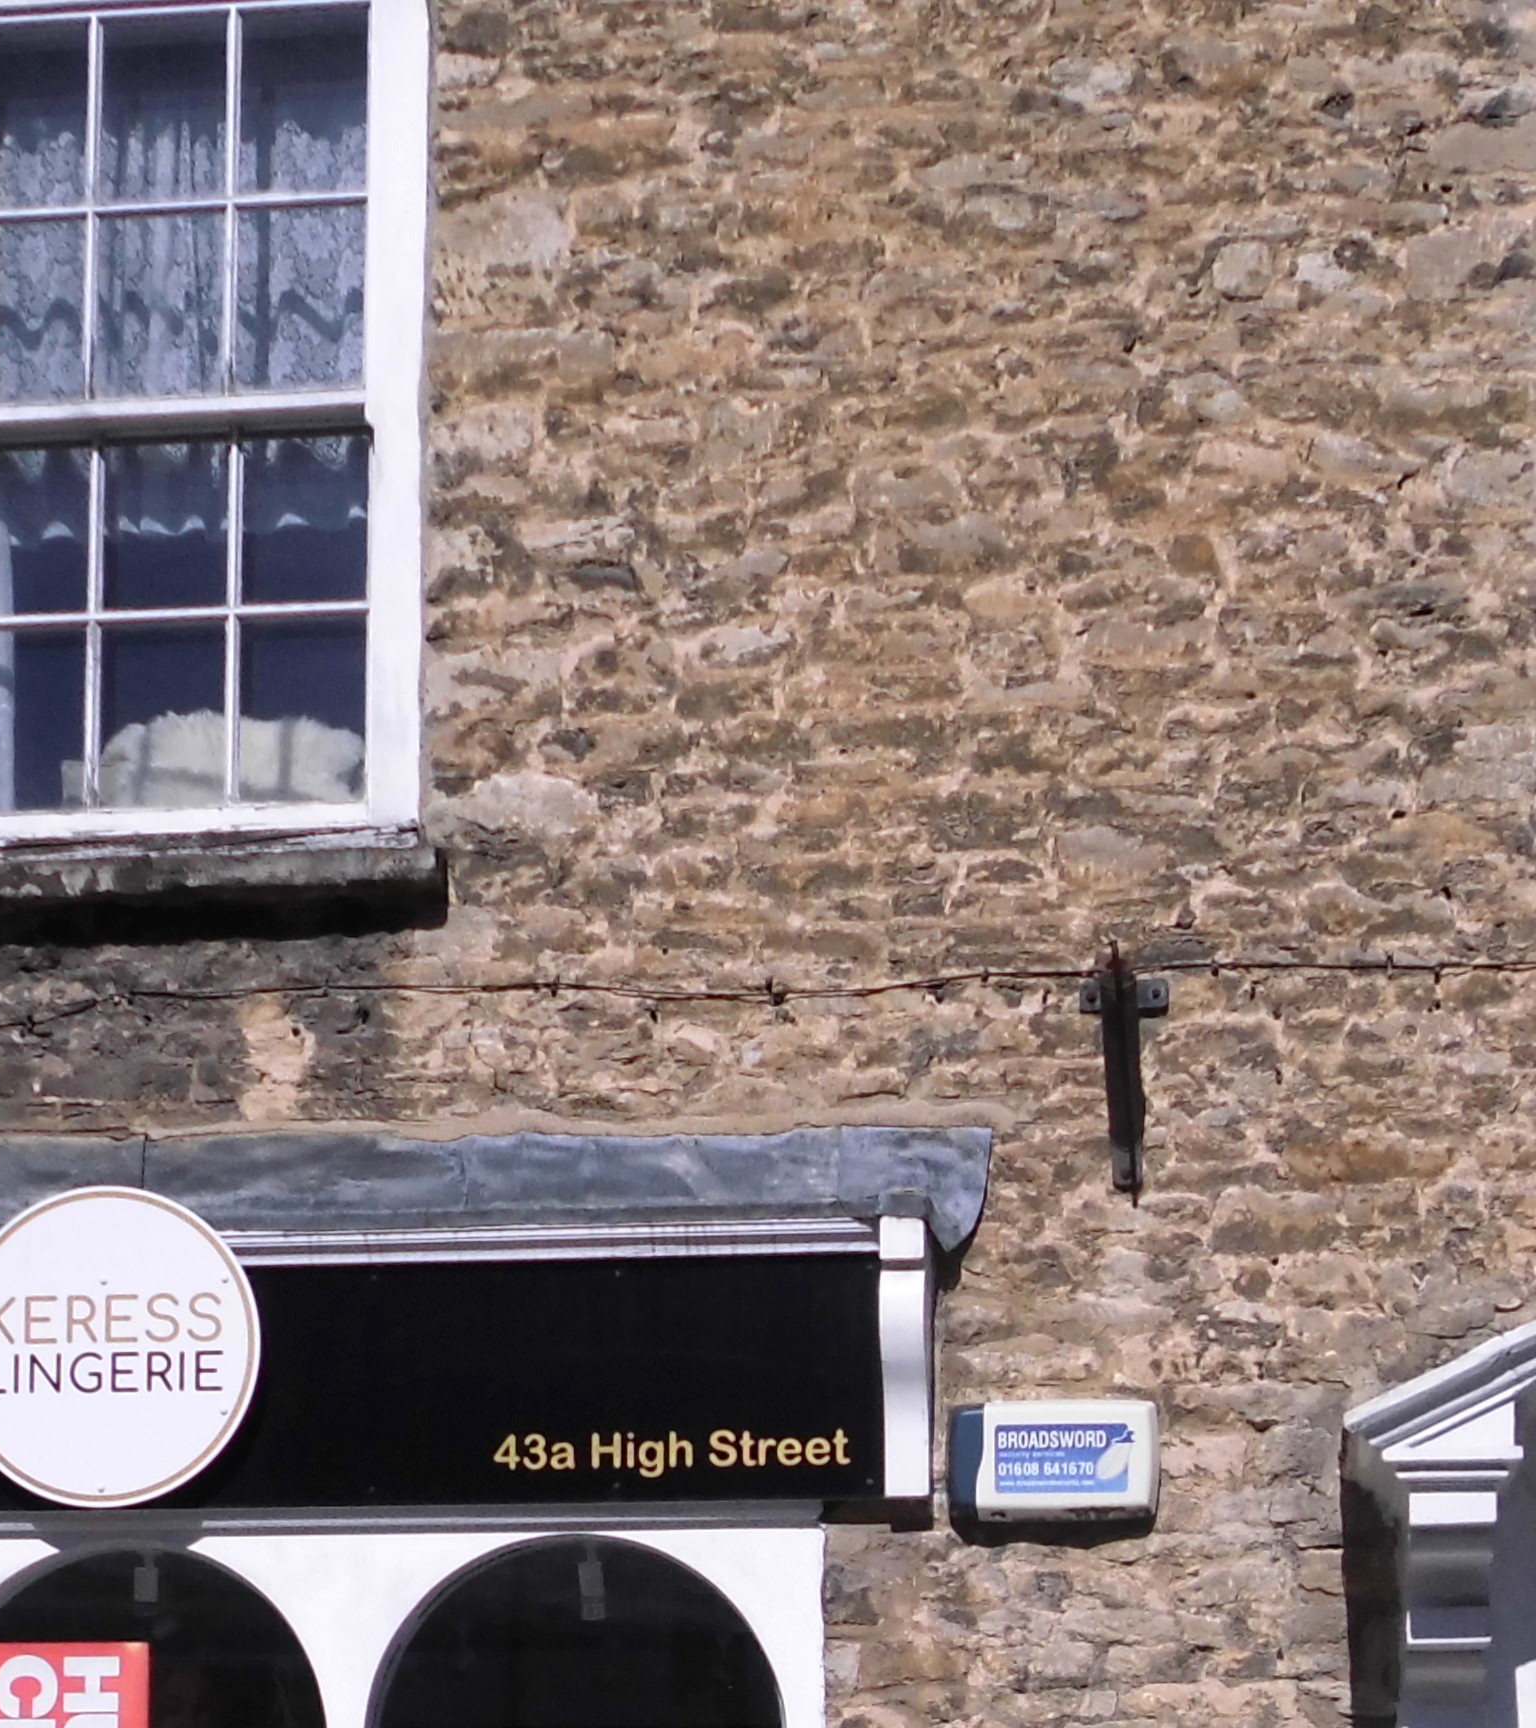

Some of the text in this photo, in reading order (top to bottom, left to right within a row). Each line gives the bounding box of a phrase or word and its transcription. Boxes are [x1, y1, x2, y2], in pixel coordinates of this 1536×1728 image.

[997, 1430, 1107, 1449] BROADSWORD
[493, 1427, 851, 1479] 43a High Street
[997, 1461, 1095, 1477] 01608 641670
